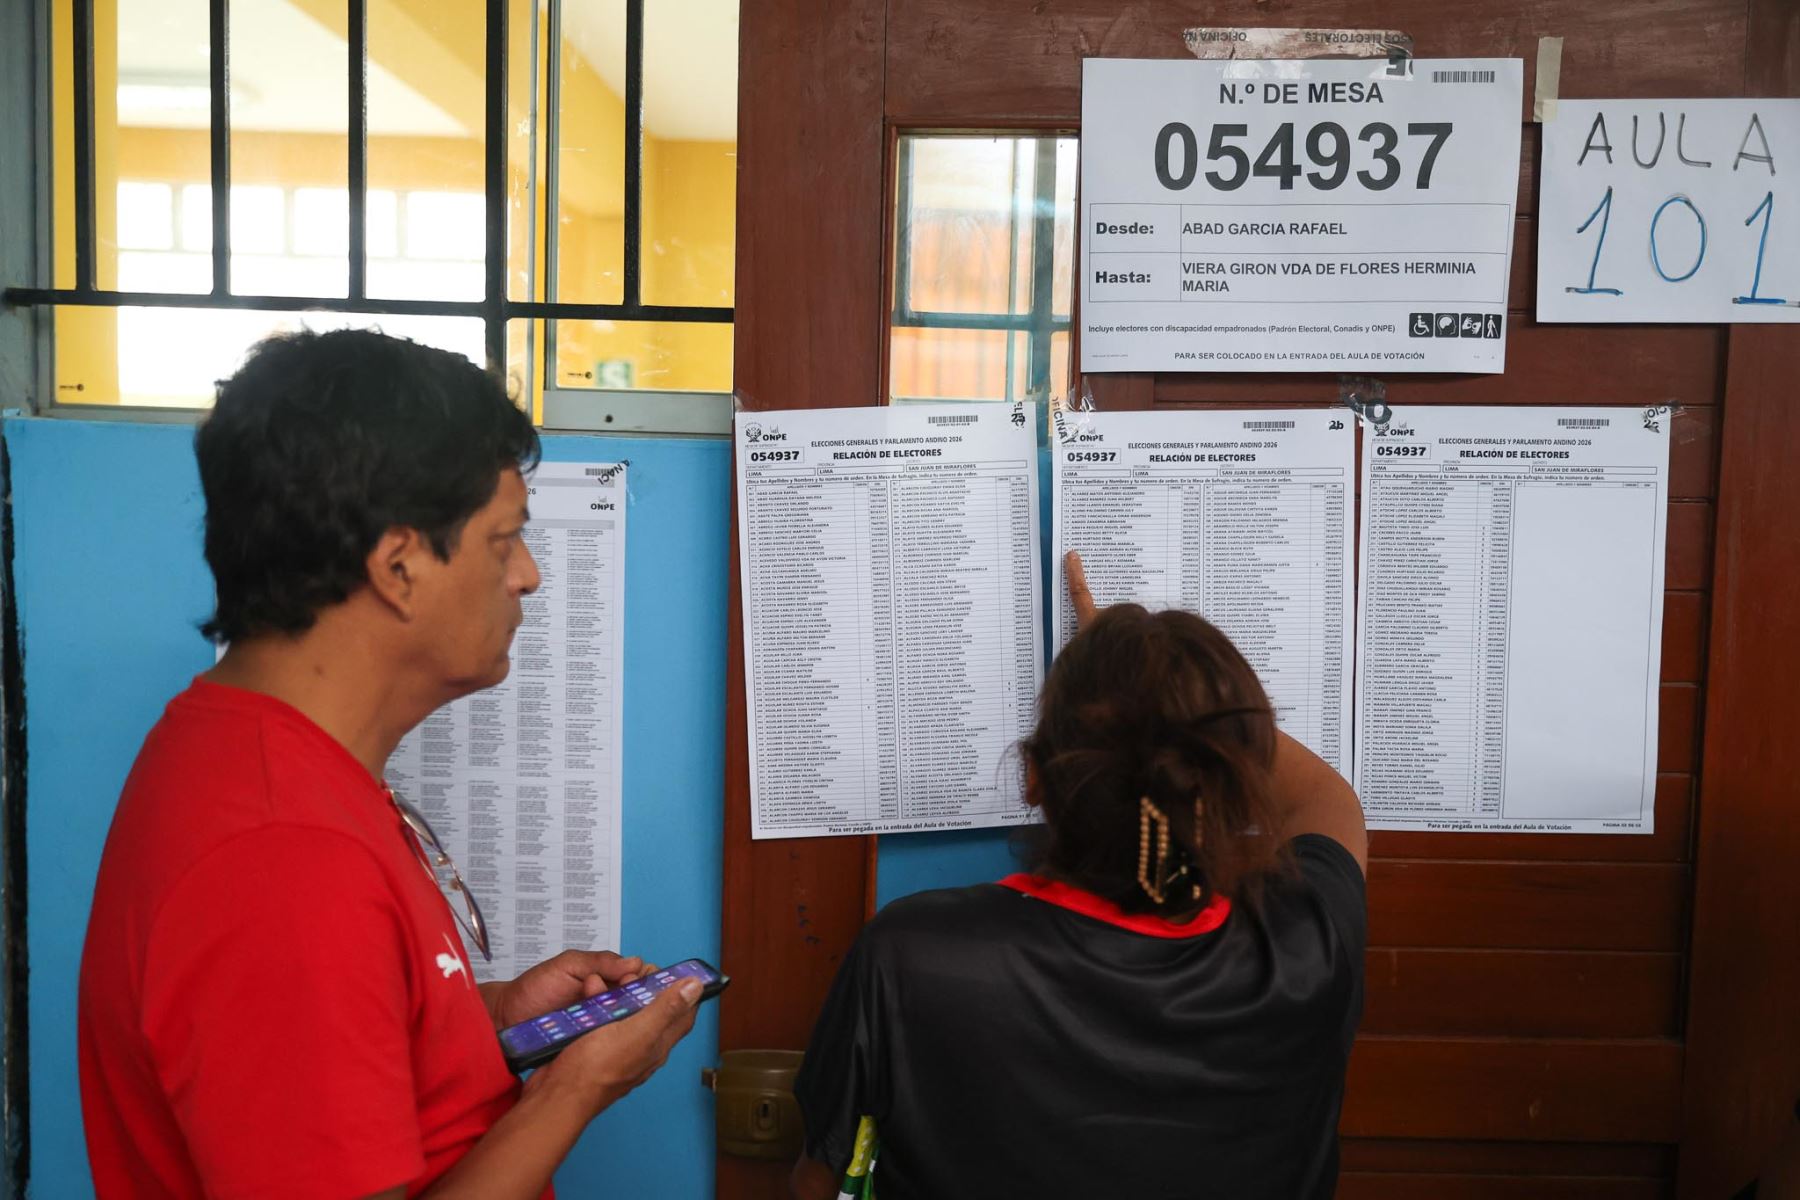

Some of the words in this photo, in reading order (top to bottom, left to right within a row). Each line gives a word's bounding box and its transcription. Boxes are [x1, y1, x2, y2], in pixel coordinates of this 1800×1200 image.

[1200, 31, 1247, 42] OFICINA
[1220, 83, 1254, 104] N.º
[1263, 83, 1298, 103] DE
[1308, 82, 1383, 103] MESA
[1577, 112, 1776, 176] AULA
[1154, 121, 1452, 191] 054937
[1096, 222, 1153, 234] Desde:
[1182, 222, 1223, 234] ABAD
[1228, 223, 1285, 235] GARCIA
[1289, 222, 1347, 234] RAFAEL
[1565, 186, 1800, 306] 101
[1182, 262, 1226, 274] VIERA
[1230, 262, 1276, 274] GIRON
[1281, 263, 1311, 274] VDA
[1316, 263, 1335, 274] DE
[1340, 262, 1399, 274] FLORES
[1404, 262, 1476, 274] HERMINIA
[1095, 271, 1150, 283] Hasta:
[1182, 280, 1229, 291] MARIA
[1088, 325, 1114, 333] Incluye
[1165, 324, 1212, 332] discapacidad
[1213, 325, 1266, 333] empadronados
[1268, 325, 1296, 333] (Padrón
[1371, 324, 1395, 333] ONPE)
[750, 450, 799, 461] 054937
[833, 450, 876, 460] RELACIÓN
[893, 448, 941, 457] ELECTORES
[1067, 452, 1116, 461] 054937
[1149, 452, 1191, 462] RELACIÓN
[1376, 446, 1426, 456] 054937
